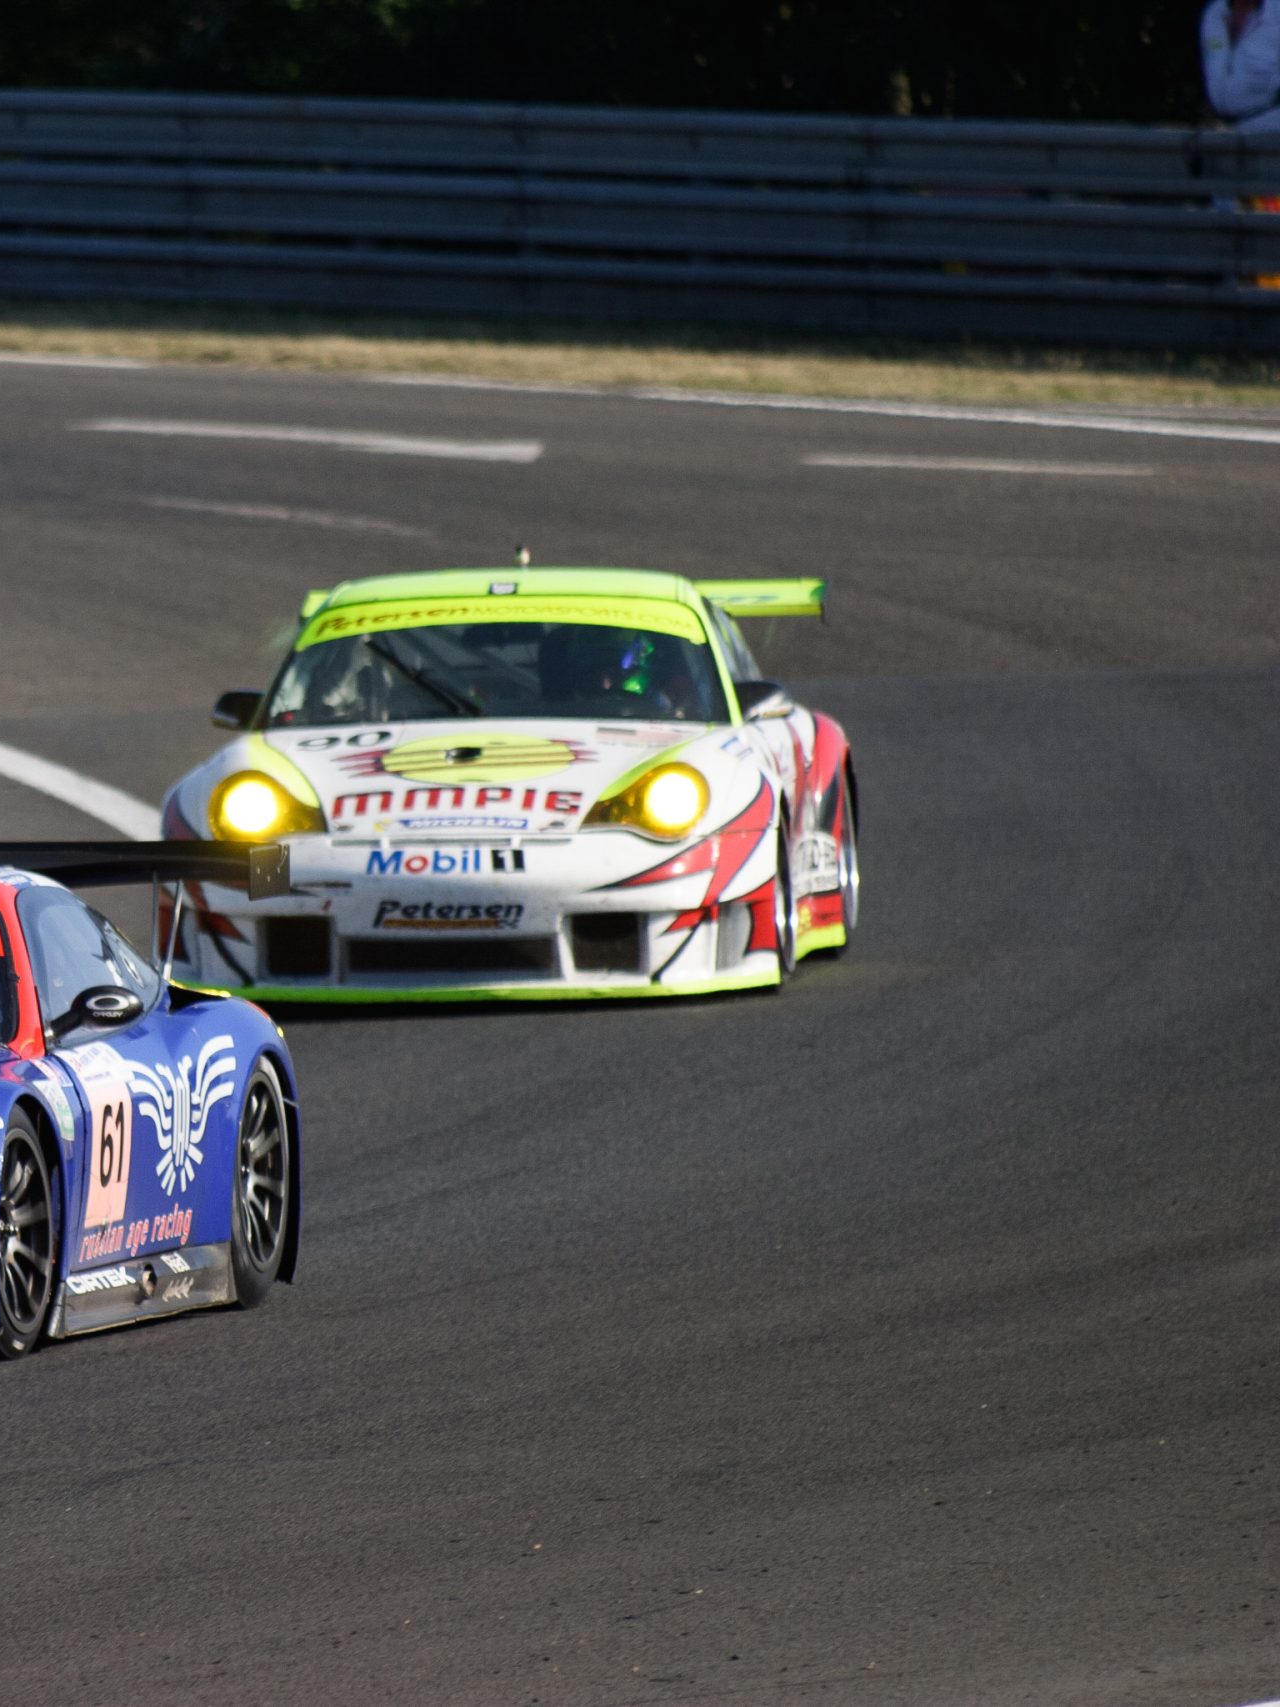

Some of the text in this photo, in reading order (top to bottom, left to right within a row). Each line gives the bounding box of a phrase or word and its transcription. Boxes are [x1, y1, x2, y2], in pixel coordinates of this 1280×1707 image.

[297, 731, 391, 750] 90
[366, 849, 520, 875] Mobil 1
[373, 901, 525, 928] Petersen
[99, 1101, 126, 1188] 61
[126, 1218, 150, 1257] age
[151, 1202, 193, 1245] racing
[66, 1266, 136, 1294] CIRTEK
